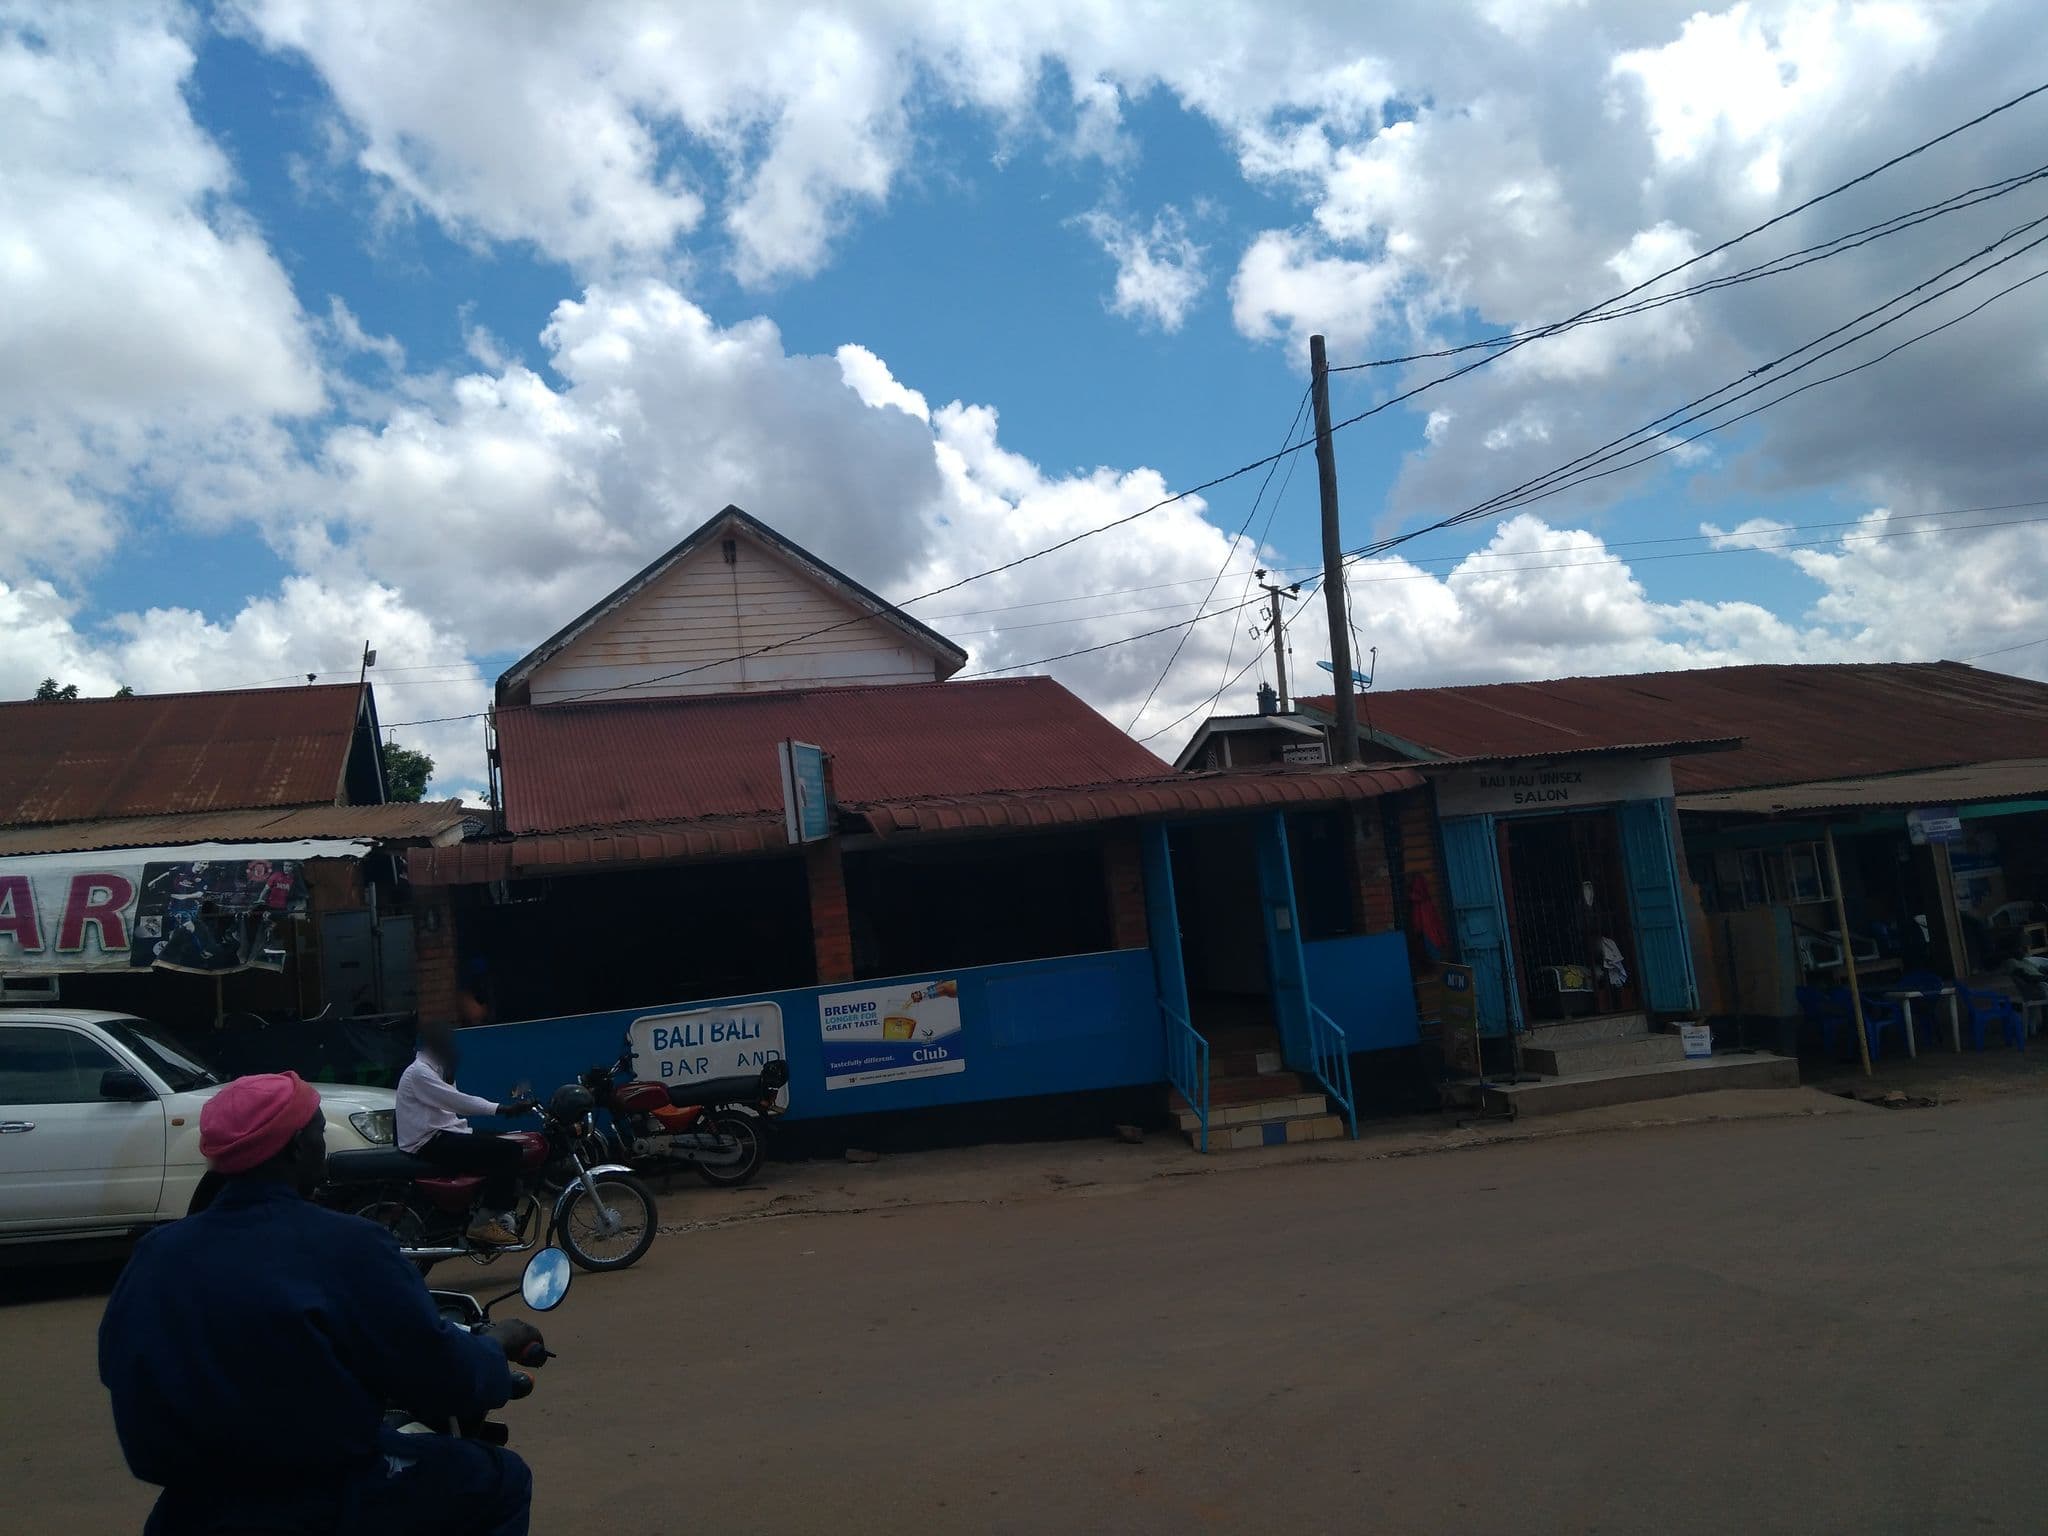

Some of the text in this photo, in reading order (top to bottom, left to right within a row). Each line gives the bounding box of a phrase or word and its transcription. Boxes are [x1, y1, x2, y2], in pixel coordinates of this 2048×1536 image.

[1539, 772, 1582, 785] UNISEX
[1514, 788, 1568, 804] SALON
[824, 1001, 877, 1017] BREWED
[825, 1011, 877, 1025] LONGER FOR
[825, 1019, 880, 1032] GREAT TASTE.
[653, 1017, 760, 1051] BALI BALI
[912, 1046, 948, 1062] Club
[661, 1050, 780, 1078] BAR AND
[830, 1058, 862, 1071] Tastefully
